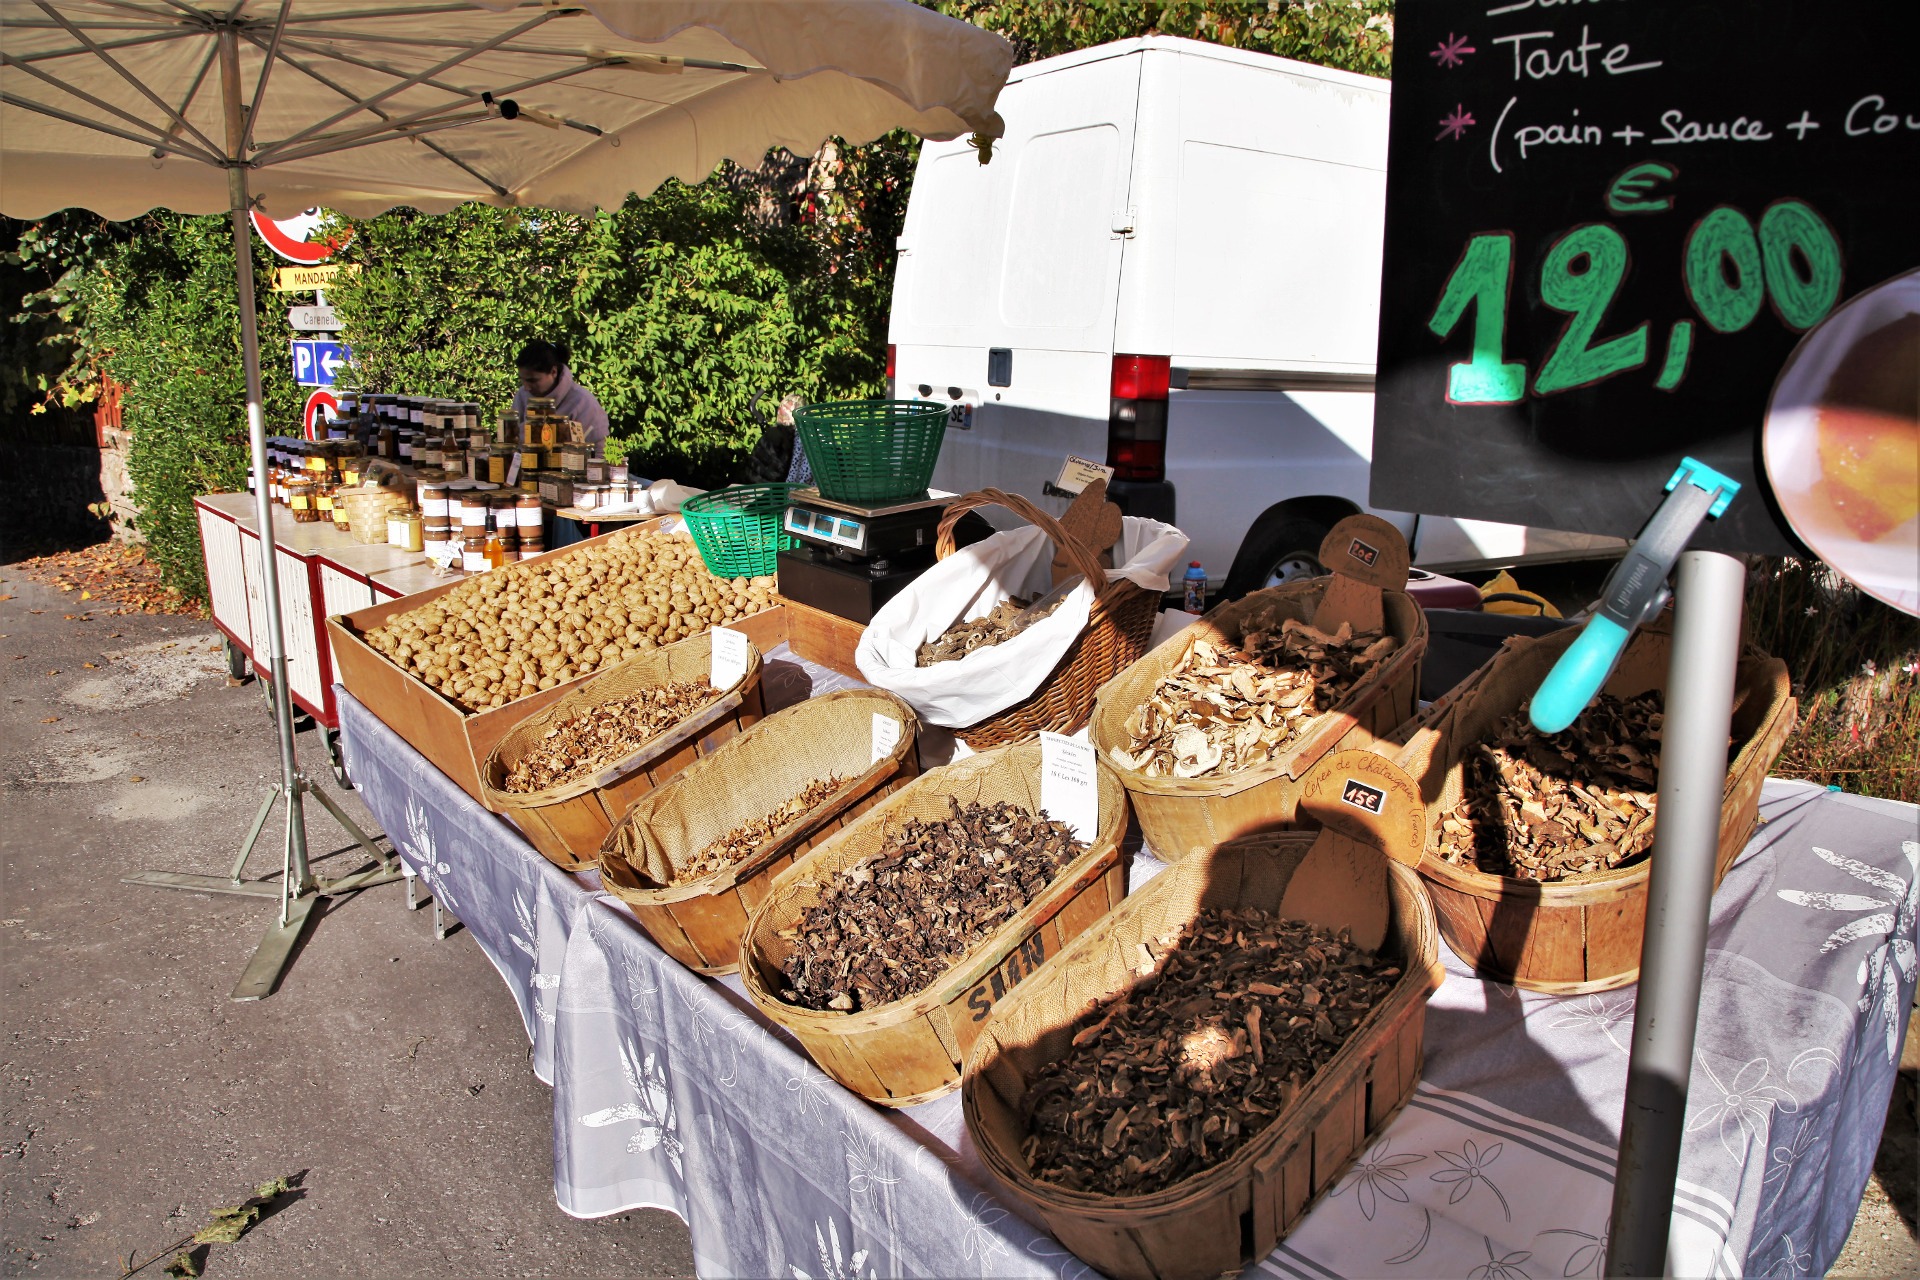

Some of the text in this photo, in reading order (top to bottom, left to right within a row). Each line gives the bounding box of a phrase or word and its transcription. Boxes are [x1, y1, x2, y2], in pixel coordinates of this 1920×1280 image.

[1492, 24, 1663, 81] Tarte
[1490, 96, 1602, 173] (pain
[1612, 125, 1644, 146] +
[1651, 109, 1773, 144] Sauce
[1786, 110, 1820, 140] +
[1608, 162, 1678, 214] €
[295, 271, 339, 285] MANDAJO
[1428, 200, 1843, 404] 12,00
[296, 346, 311, 379] P
[1336, 758, 1351, 770] de
[1346, 788, 1378, 809] 15€
